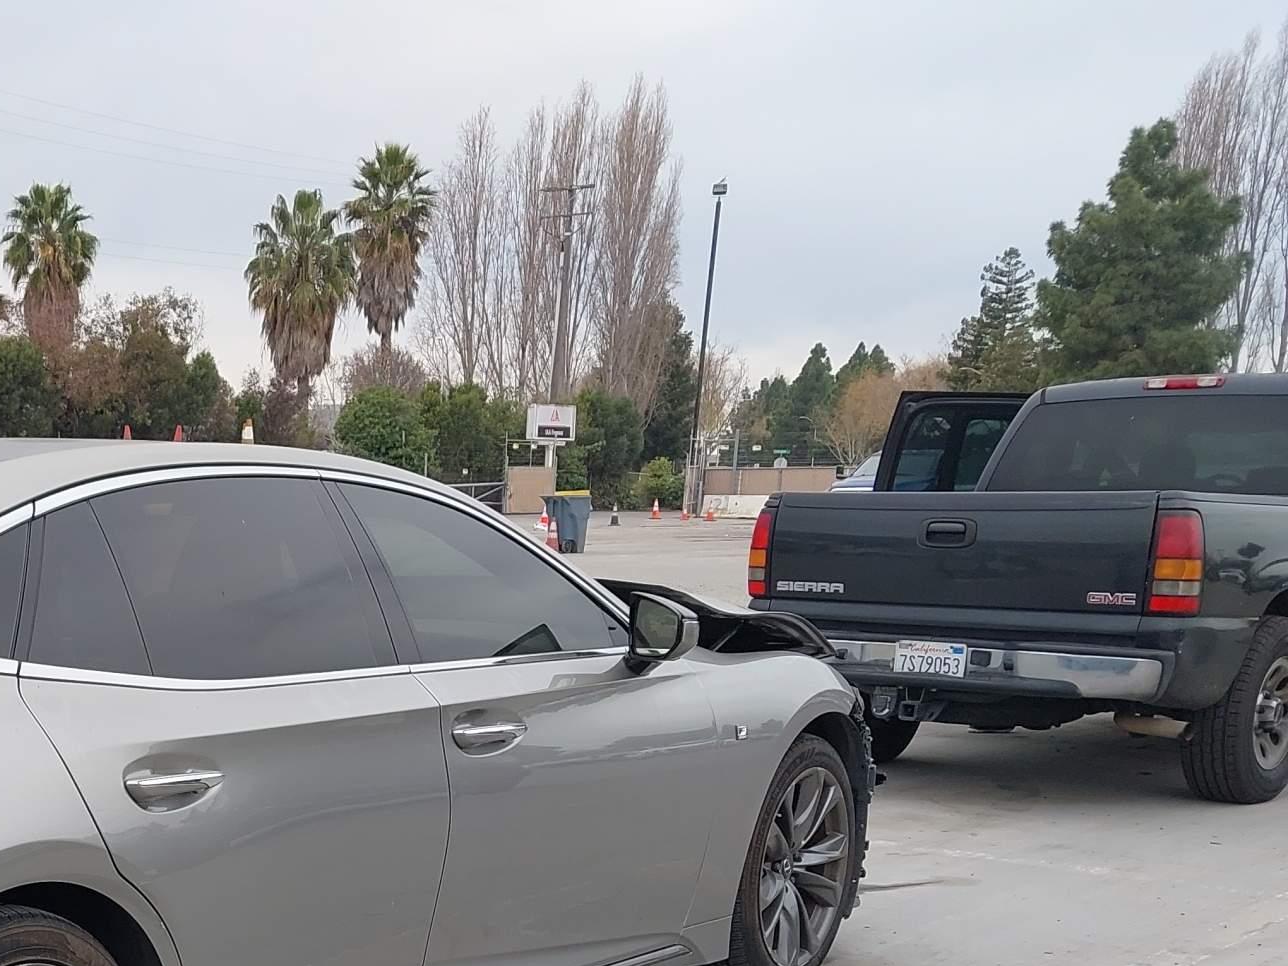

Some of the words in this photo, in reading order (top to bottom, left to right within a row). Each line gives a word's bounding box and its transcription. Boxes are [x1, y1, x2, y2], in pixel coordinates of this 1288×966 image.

[776, 581, 844, 593] SIERRA
[1087, 592, 1136, 605] GMC
[910, 643, 951, 655] California
[900, 654, 960, 675] 7S79053
